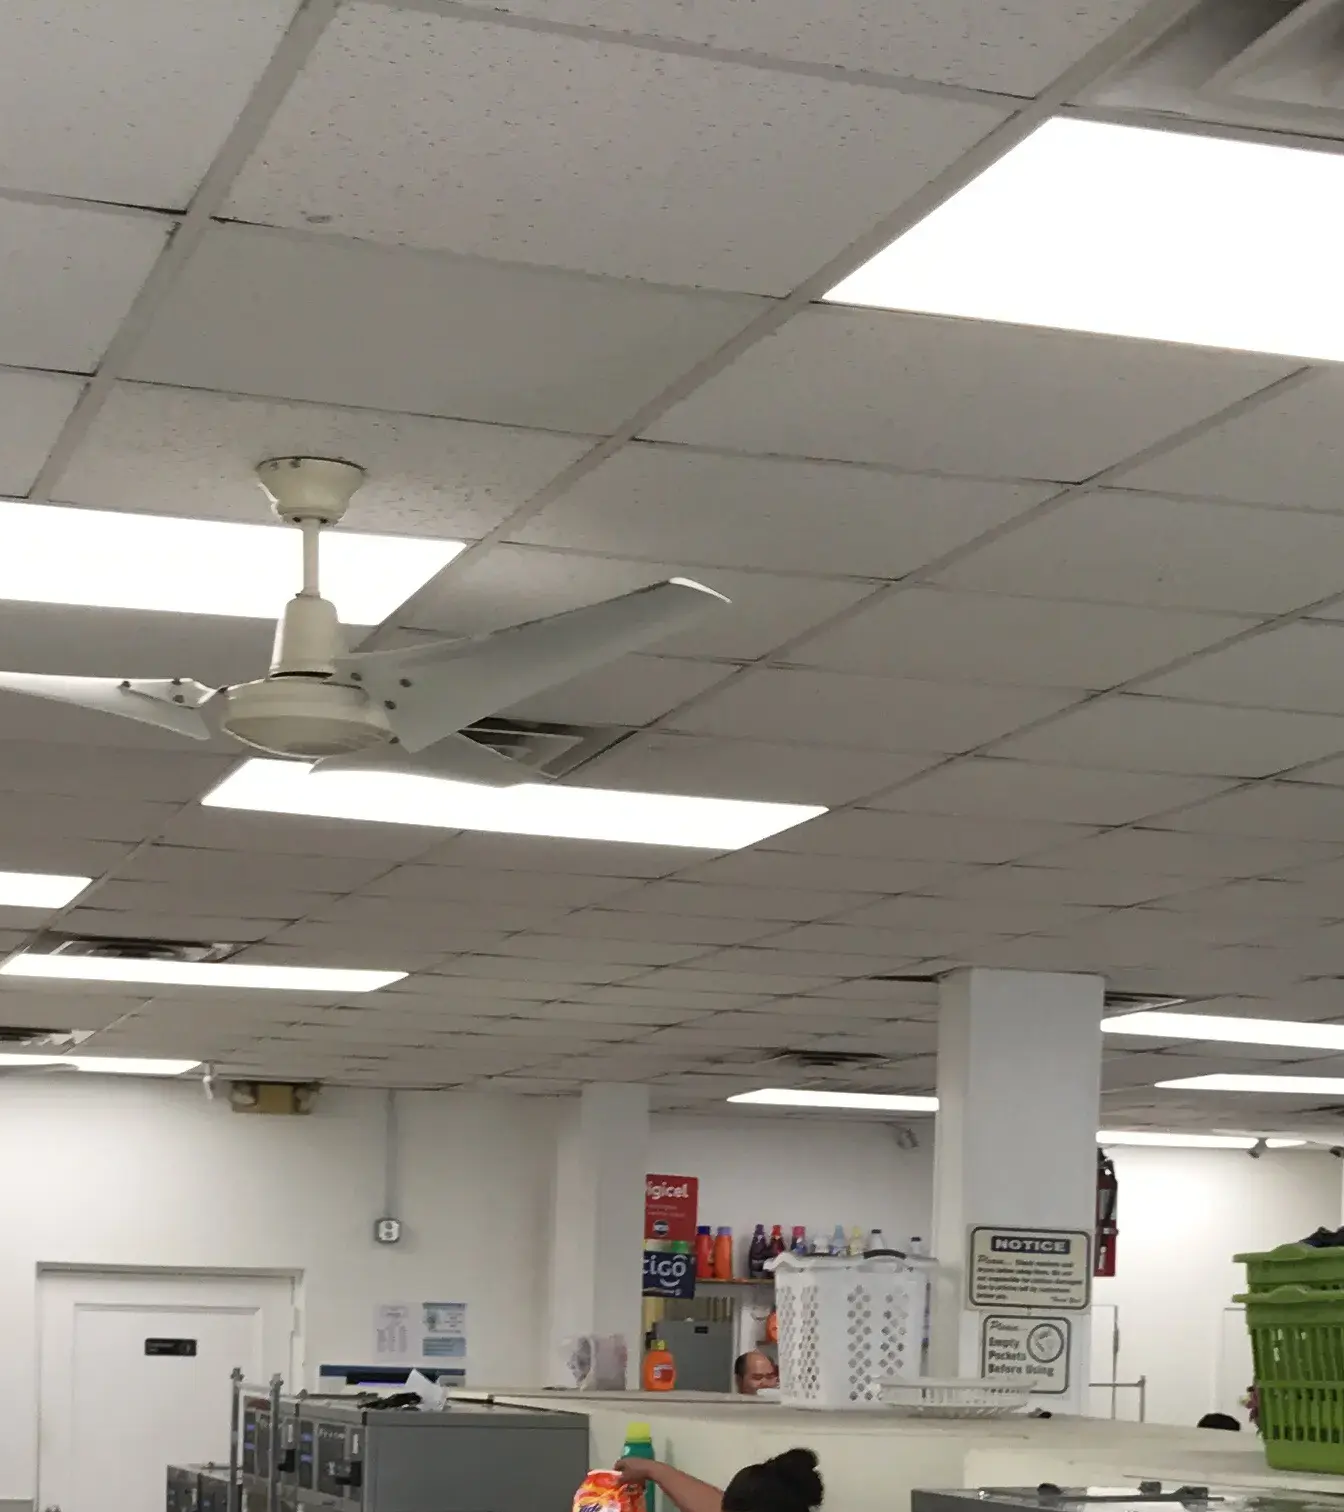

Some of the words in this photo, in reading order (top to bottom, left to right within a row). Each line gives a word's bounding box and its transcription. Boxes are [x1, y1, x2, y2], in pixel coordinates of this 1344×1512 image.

[647, 1181, 689, 1200] igicel
[995, 1239, 1066, 1252] NOTICE
[989, 1337, 1019, 1349] Empty
[988, 1350, 1026, 1361] Pockets
[988, 1363, 1022, 1374] Before
[1026, 1364, 1054, 1377] Using
